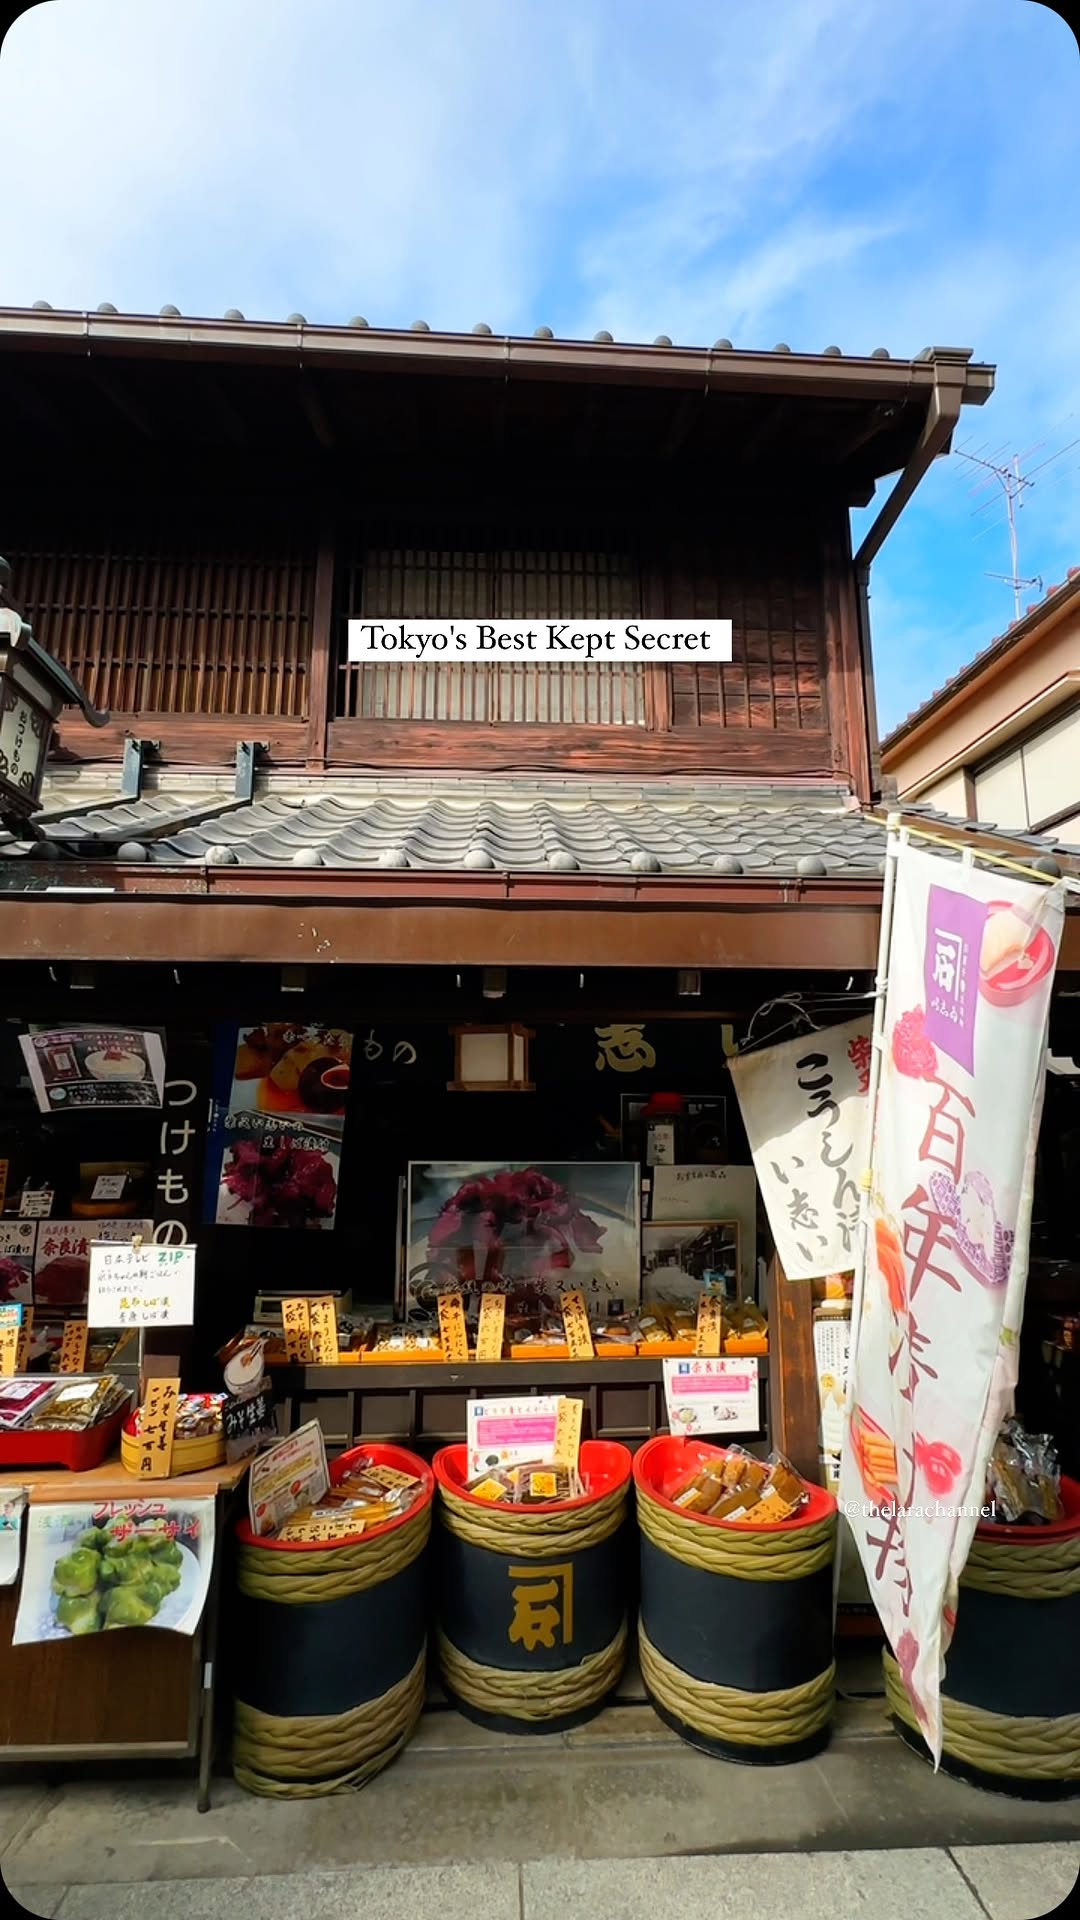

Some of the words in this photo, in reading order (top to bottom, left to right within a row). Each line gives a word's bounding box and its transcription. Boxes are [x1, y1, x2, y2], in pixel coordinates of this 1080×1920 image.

[155, 1080, 197, 1245] つけもの
[94, 1500, 167, 1519] フレッシュ
[111, 1519, 201, 1542] ザーサイ
